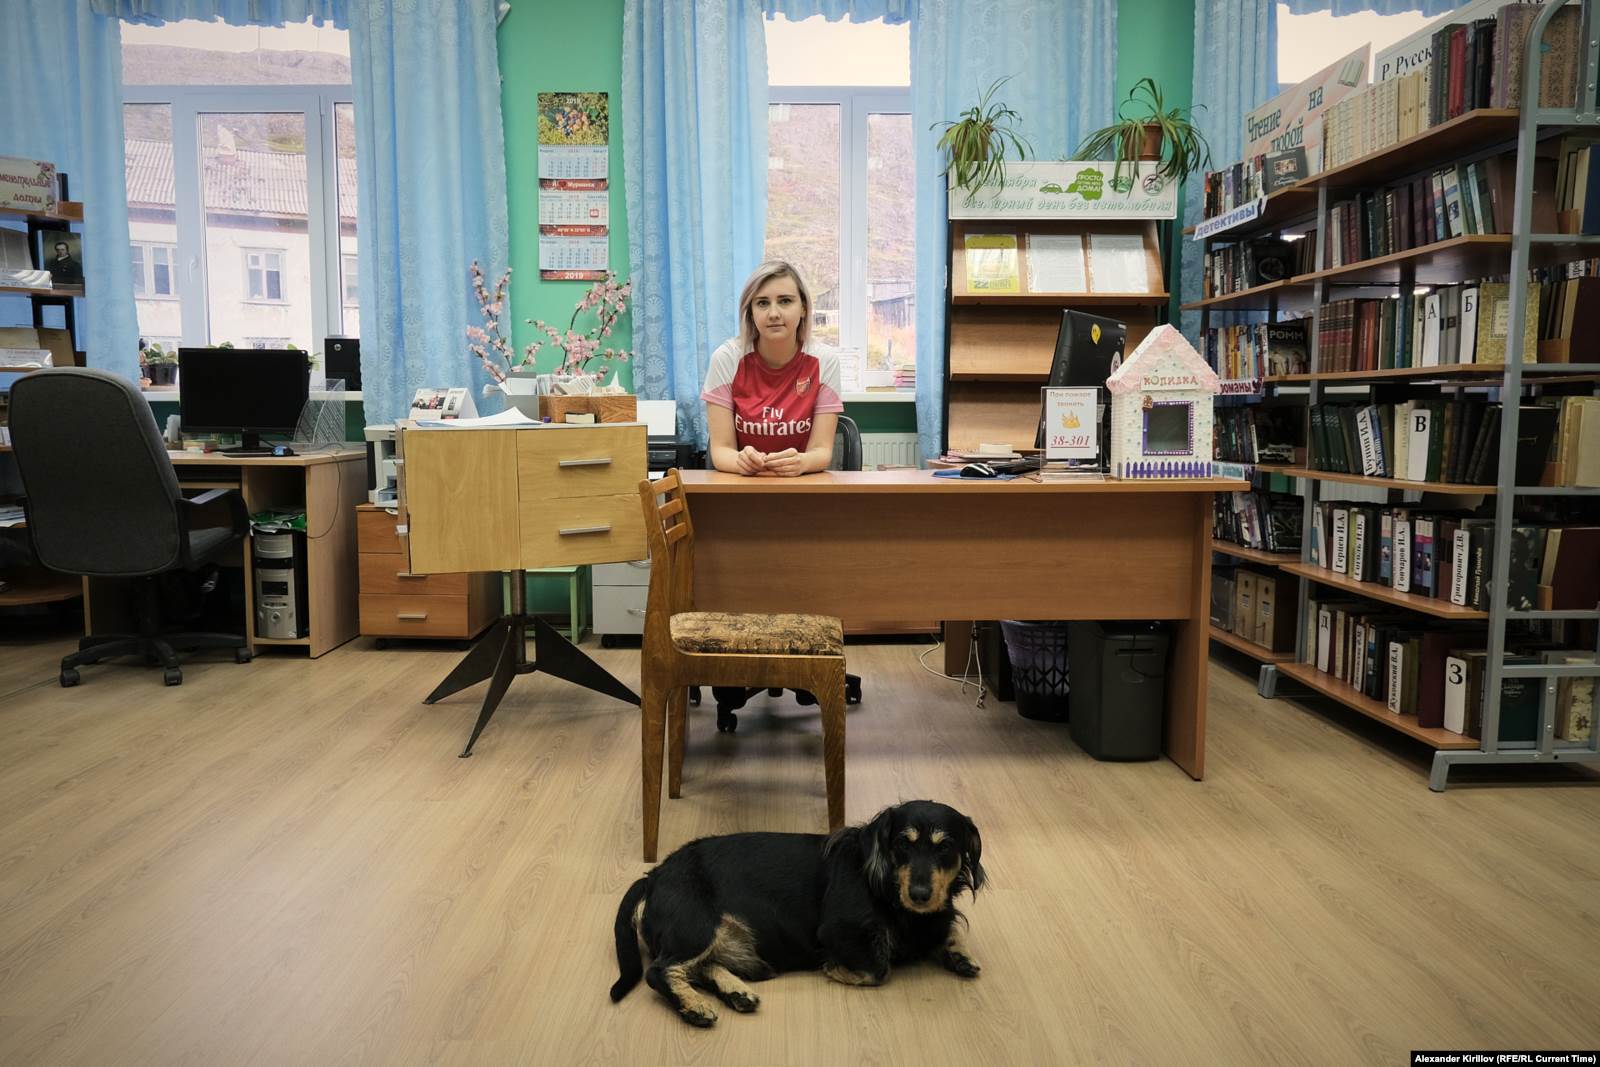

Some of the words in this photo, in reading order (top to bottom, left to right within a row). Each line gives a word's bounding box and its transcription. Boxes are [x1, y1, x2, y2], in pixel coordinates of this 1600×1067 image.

[1306, 86, 1323, 111] на
[1247, 109, 1282, 143] Чтение
[1271, 117, 1304, 152] любой
[13, 193, 42, 204] даты
[1038, 199, 1066, 210] день
[1070, 198, 1090, 210] без
[1093, 199, 1172, 211] автомобиля
[1427, 302, 1437, 320] А
[1464, 294, 1474, 313] Б
[1050, 391, 1064, 399] При
[734, 412, 812, 437] Emirates
[762, 406, 784, 420] Fly
[1414, 415, 1427, 433] В
[1051, 435, 1090, 447] 38-301
[1363, 437, 1374, 473] Бунин
[1335, 536, 1346, 569] Герцен
[1354, 543, 1363, 577] Гоголь
[1397, 549, 1408, 587] Гончаров
[1453, 553, 1464, 602] Григорович
[1320, 615, 1329, 631] Д
[1389, 664, 1399, 710] Жуковский
